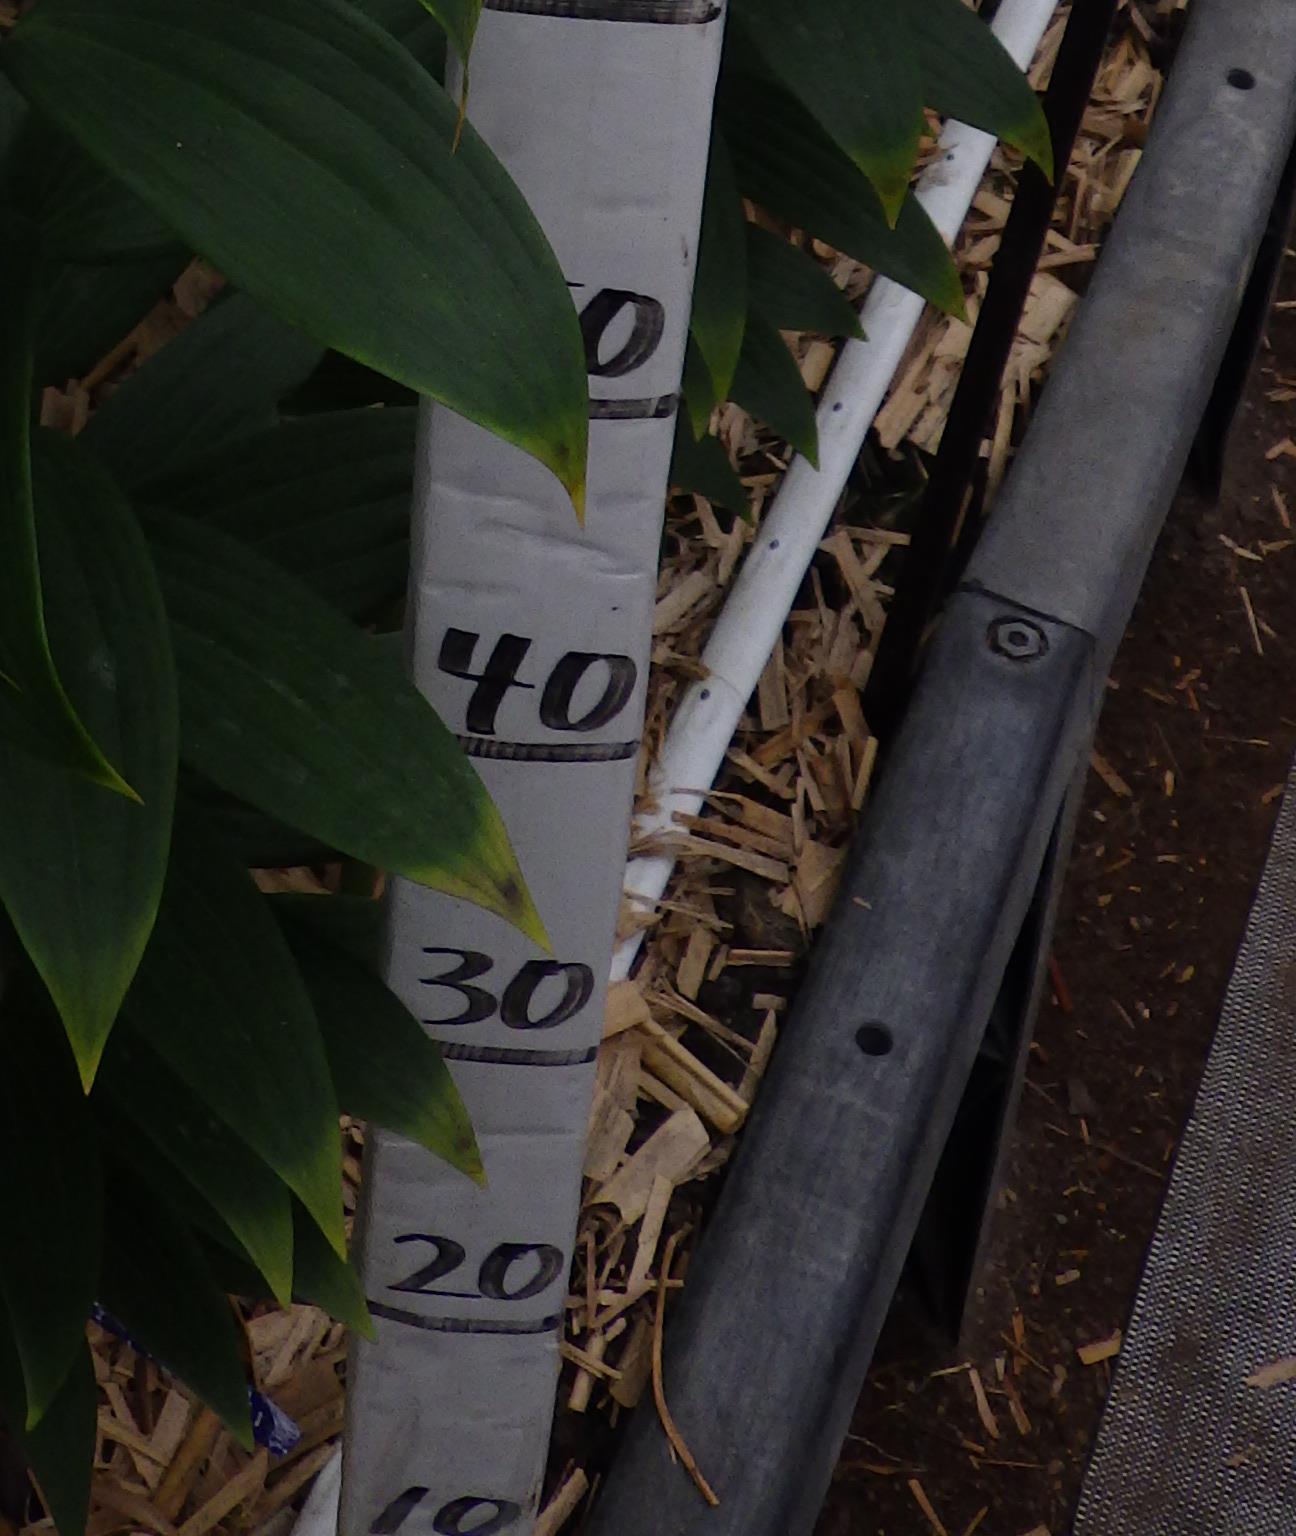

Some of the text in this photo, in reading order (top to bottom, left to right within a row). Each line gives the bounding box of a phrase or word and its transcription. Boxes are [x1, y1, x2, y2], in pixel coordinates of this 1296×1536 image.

[565, 280, 665, 378] 0
[437, 627, 637, 735] 40
[418, 946, 595, 1029] 30
[387, 1233, 564, 1301] 20
[369, 1486, 522, 1536] 10
